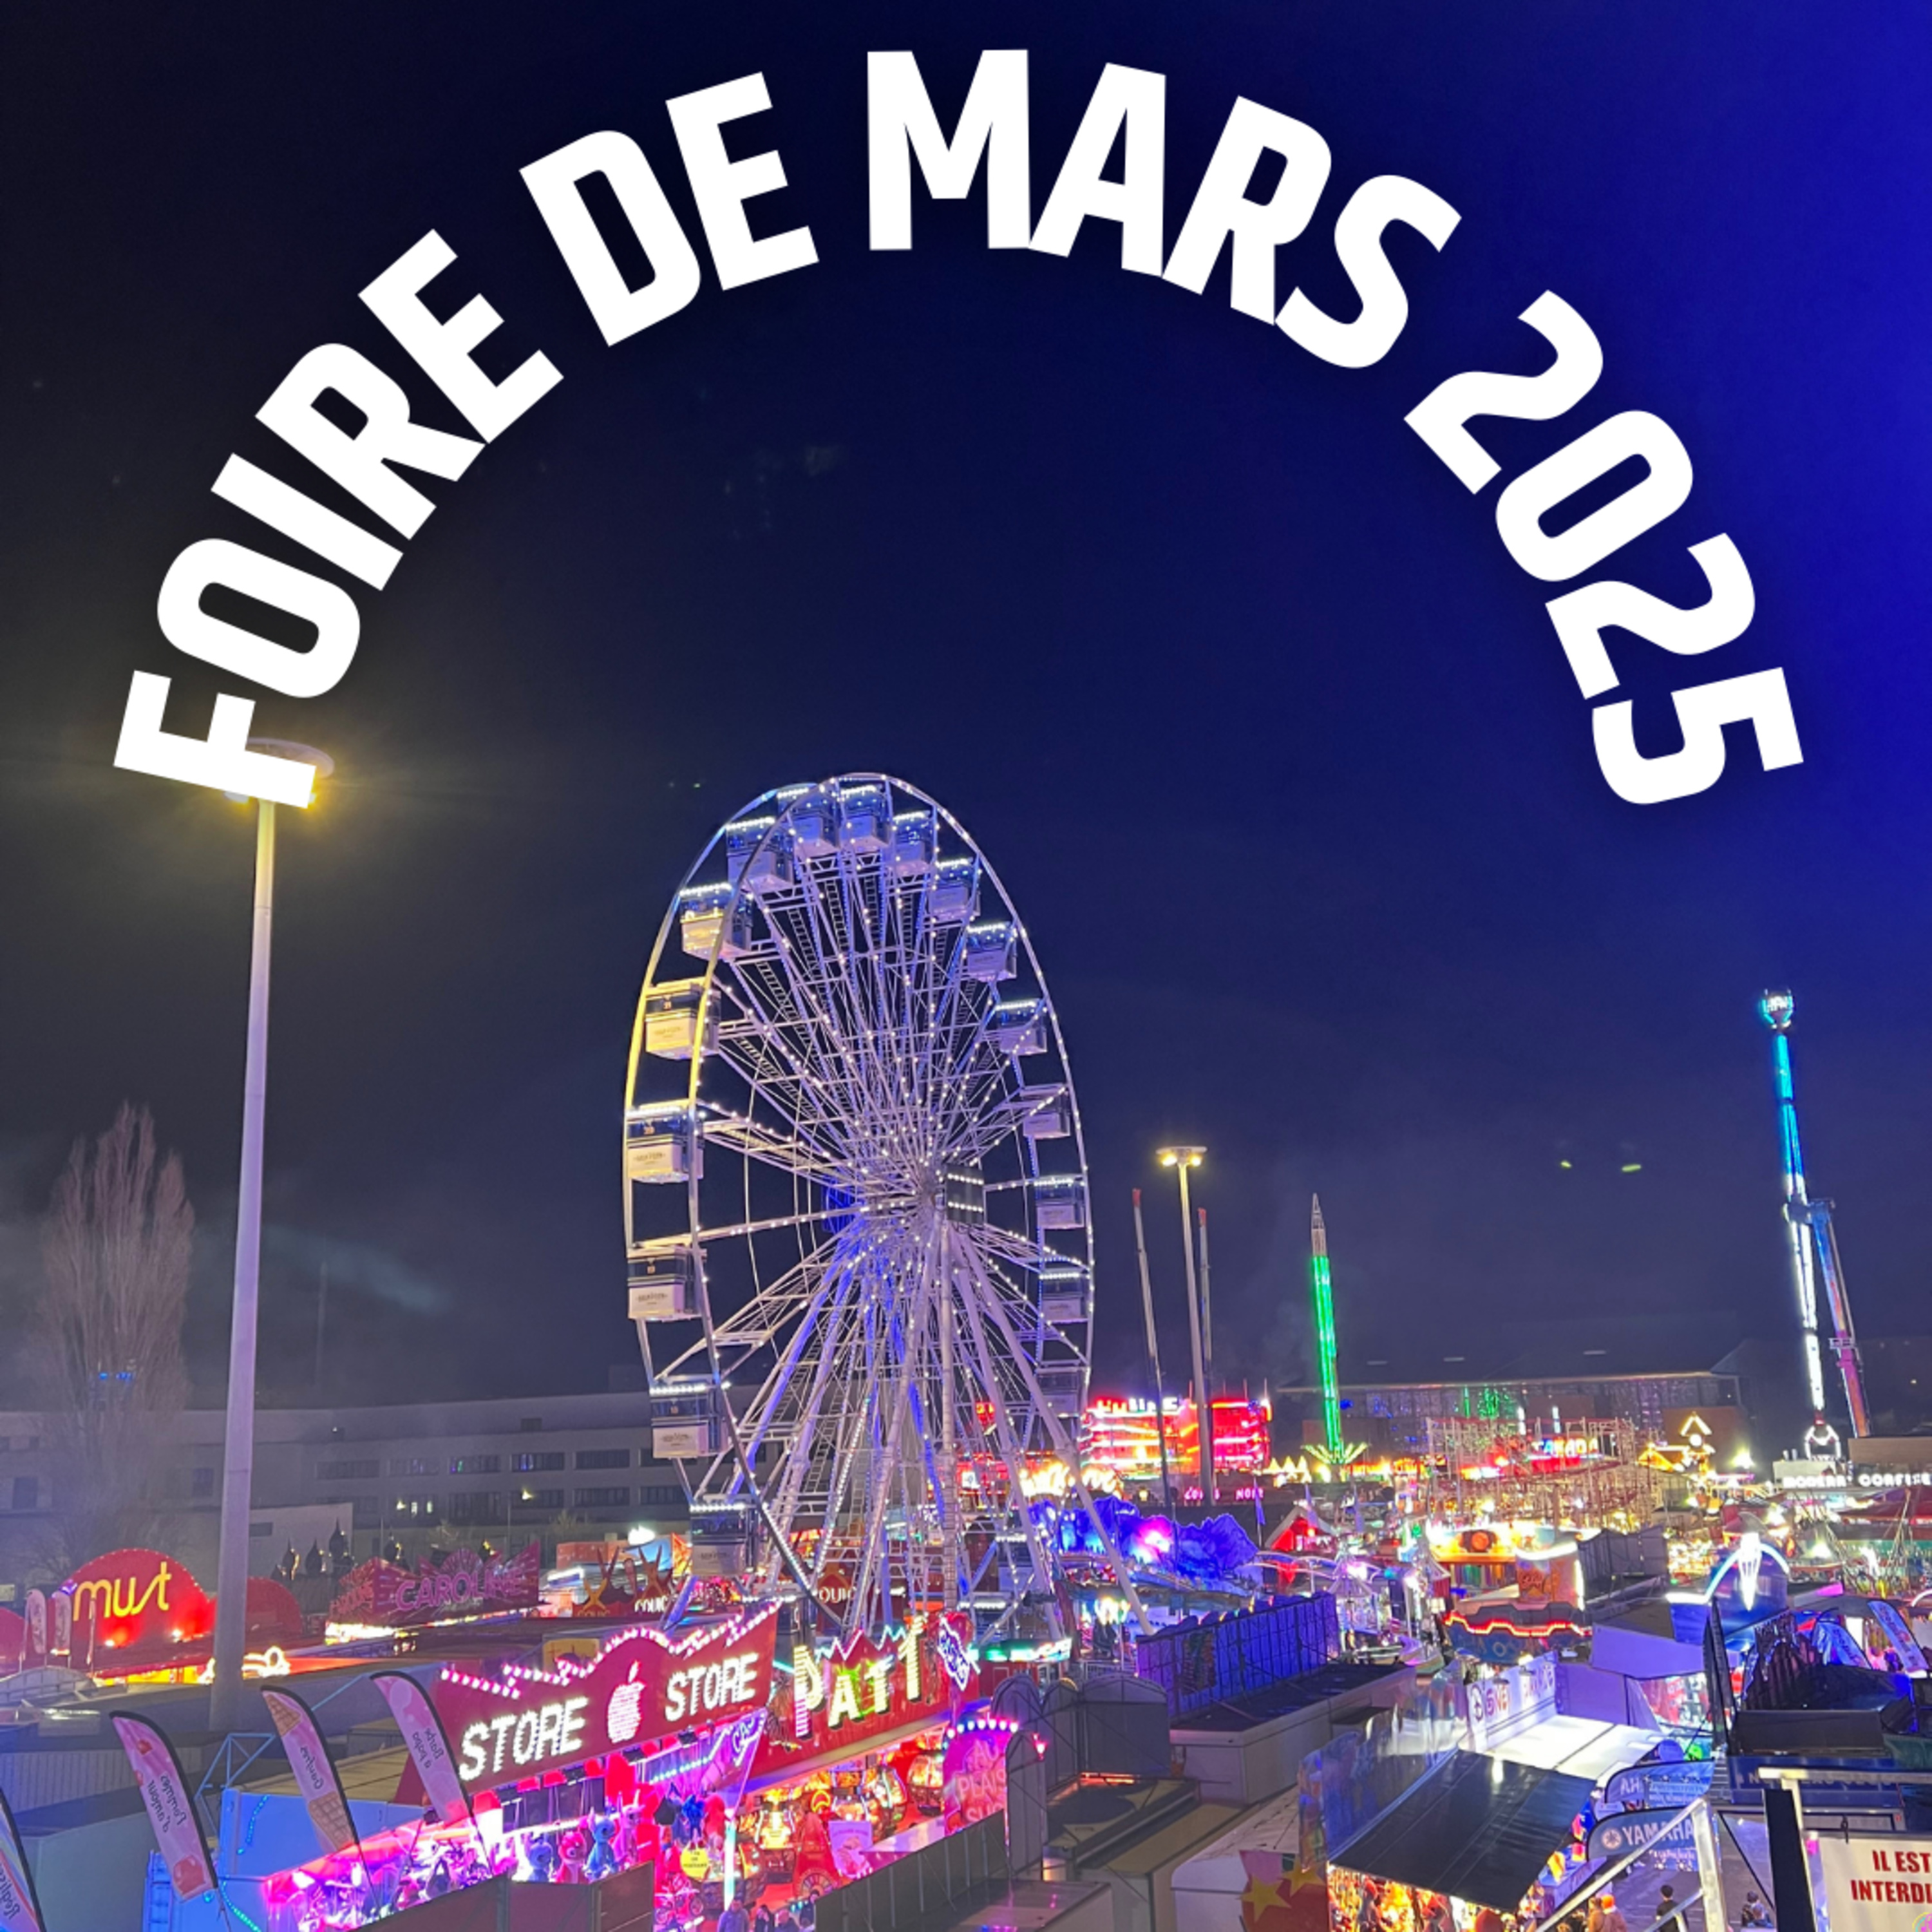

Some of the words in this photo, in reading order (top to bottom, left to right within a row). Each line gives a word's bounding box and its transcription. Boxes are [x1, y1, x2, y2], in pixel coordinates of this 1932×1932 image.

[73, 1561, 171, 1621] must
[459, 1696, 589, 1781] STORE
[665, 1653, 759, 1721] STORE
[1871, 1849, 1892, 1872] IL
[1894, 1850, 1931, 1874] EST
